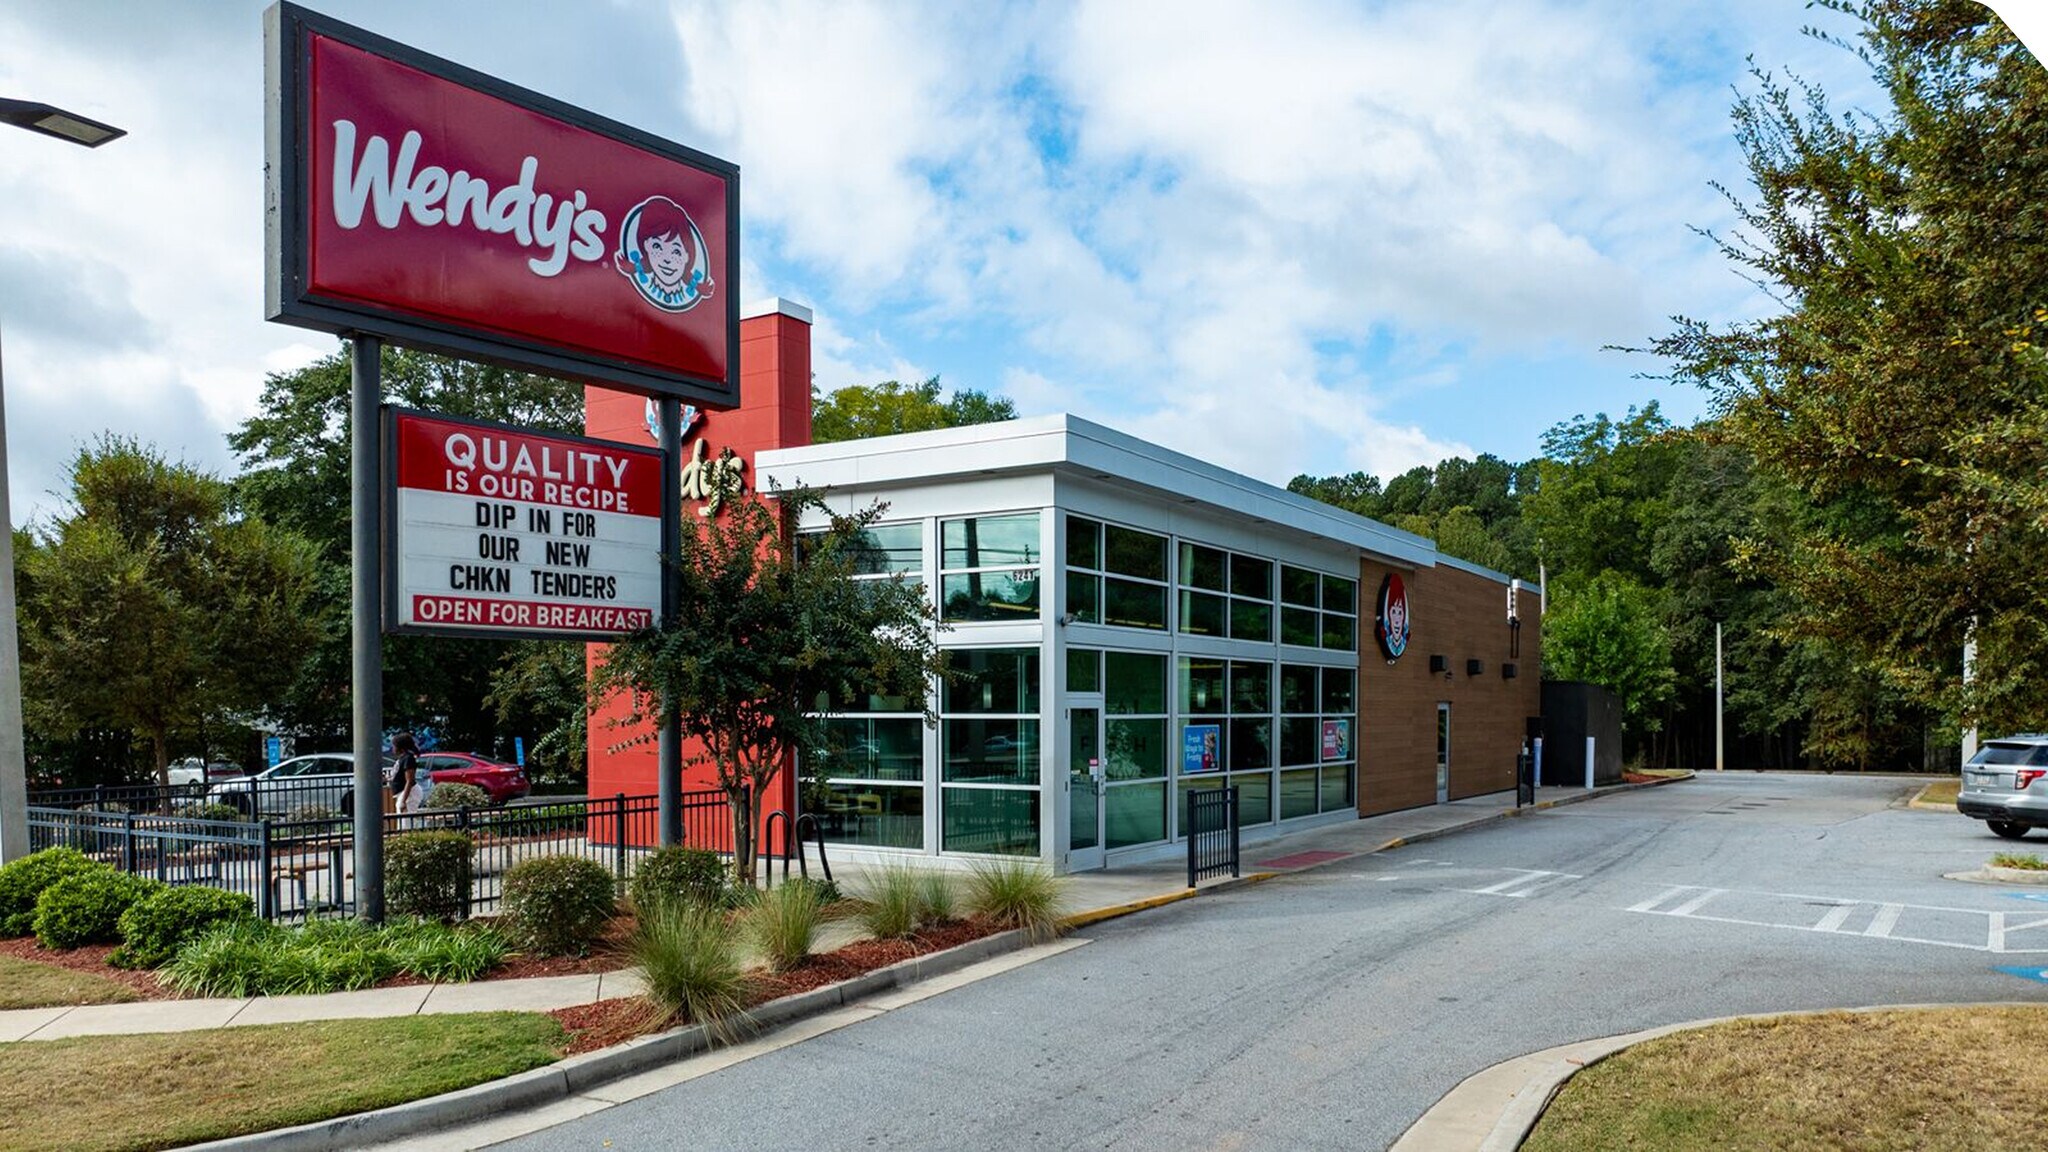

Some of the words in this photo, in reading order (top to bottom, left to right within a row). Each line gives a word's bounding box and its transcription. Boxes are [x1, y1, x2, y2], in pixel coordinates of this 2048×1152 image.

[333, 119, 607, 277] Wendy's
[445, 433, 629, 488] QUALITY
[446, 469, 469, 492] IS
[479, 474, 534, 500] OUR
[545, 483, 629, 512] RECIPE
[476, 502, 516, 529] DIP
[529, 508, 550, 533] IN
[563, 512, 596, 538] FOR
[479, 533, 519, 562] OUR
[546, 541, 590, 567] NEW
[450, 564, 510, 593] CHKN
[530, 570, 616, 599] TENDERS
[419, 599, 482, 622] OPEN
[490, 603, 530, 625] FOR
[537, 606, 648, 630] BREAKFAST
